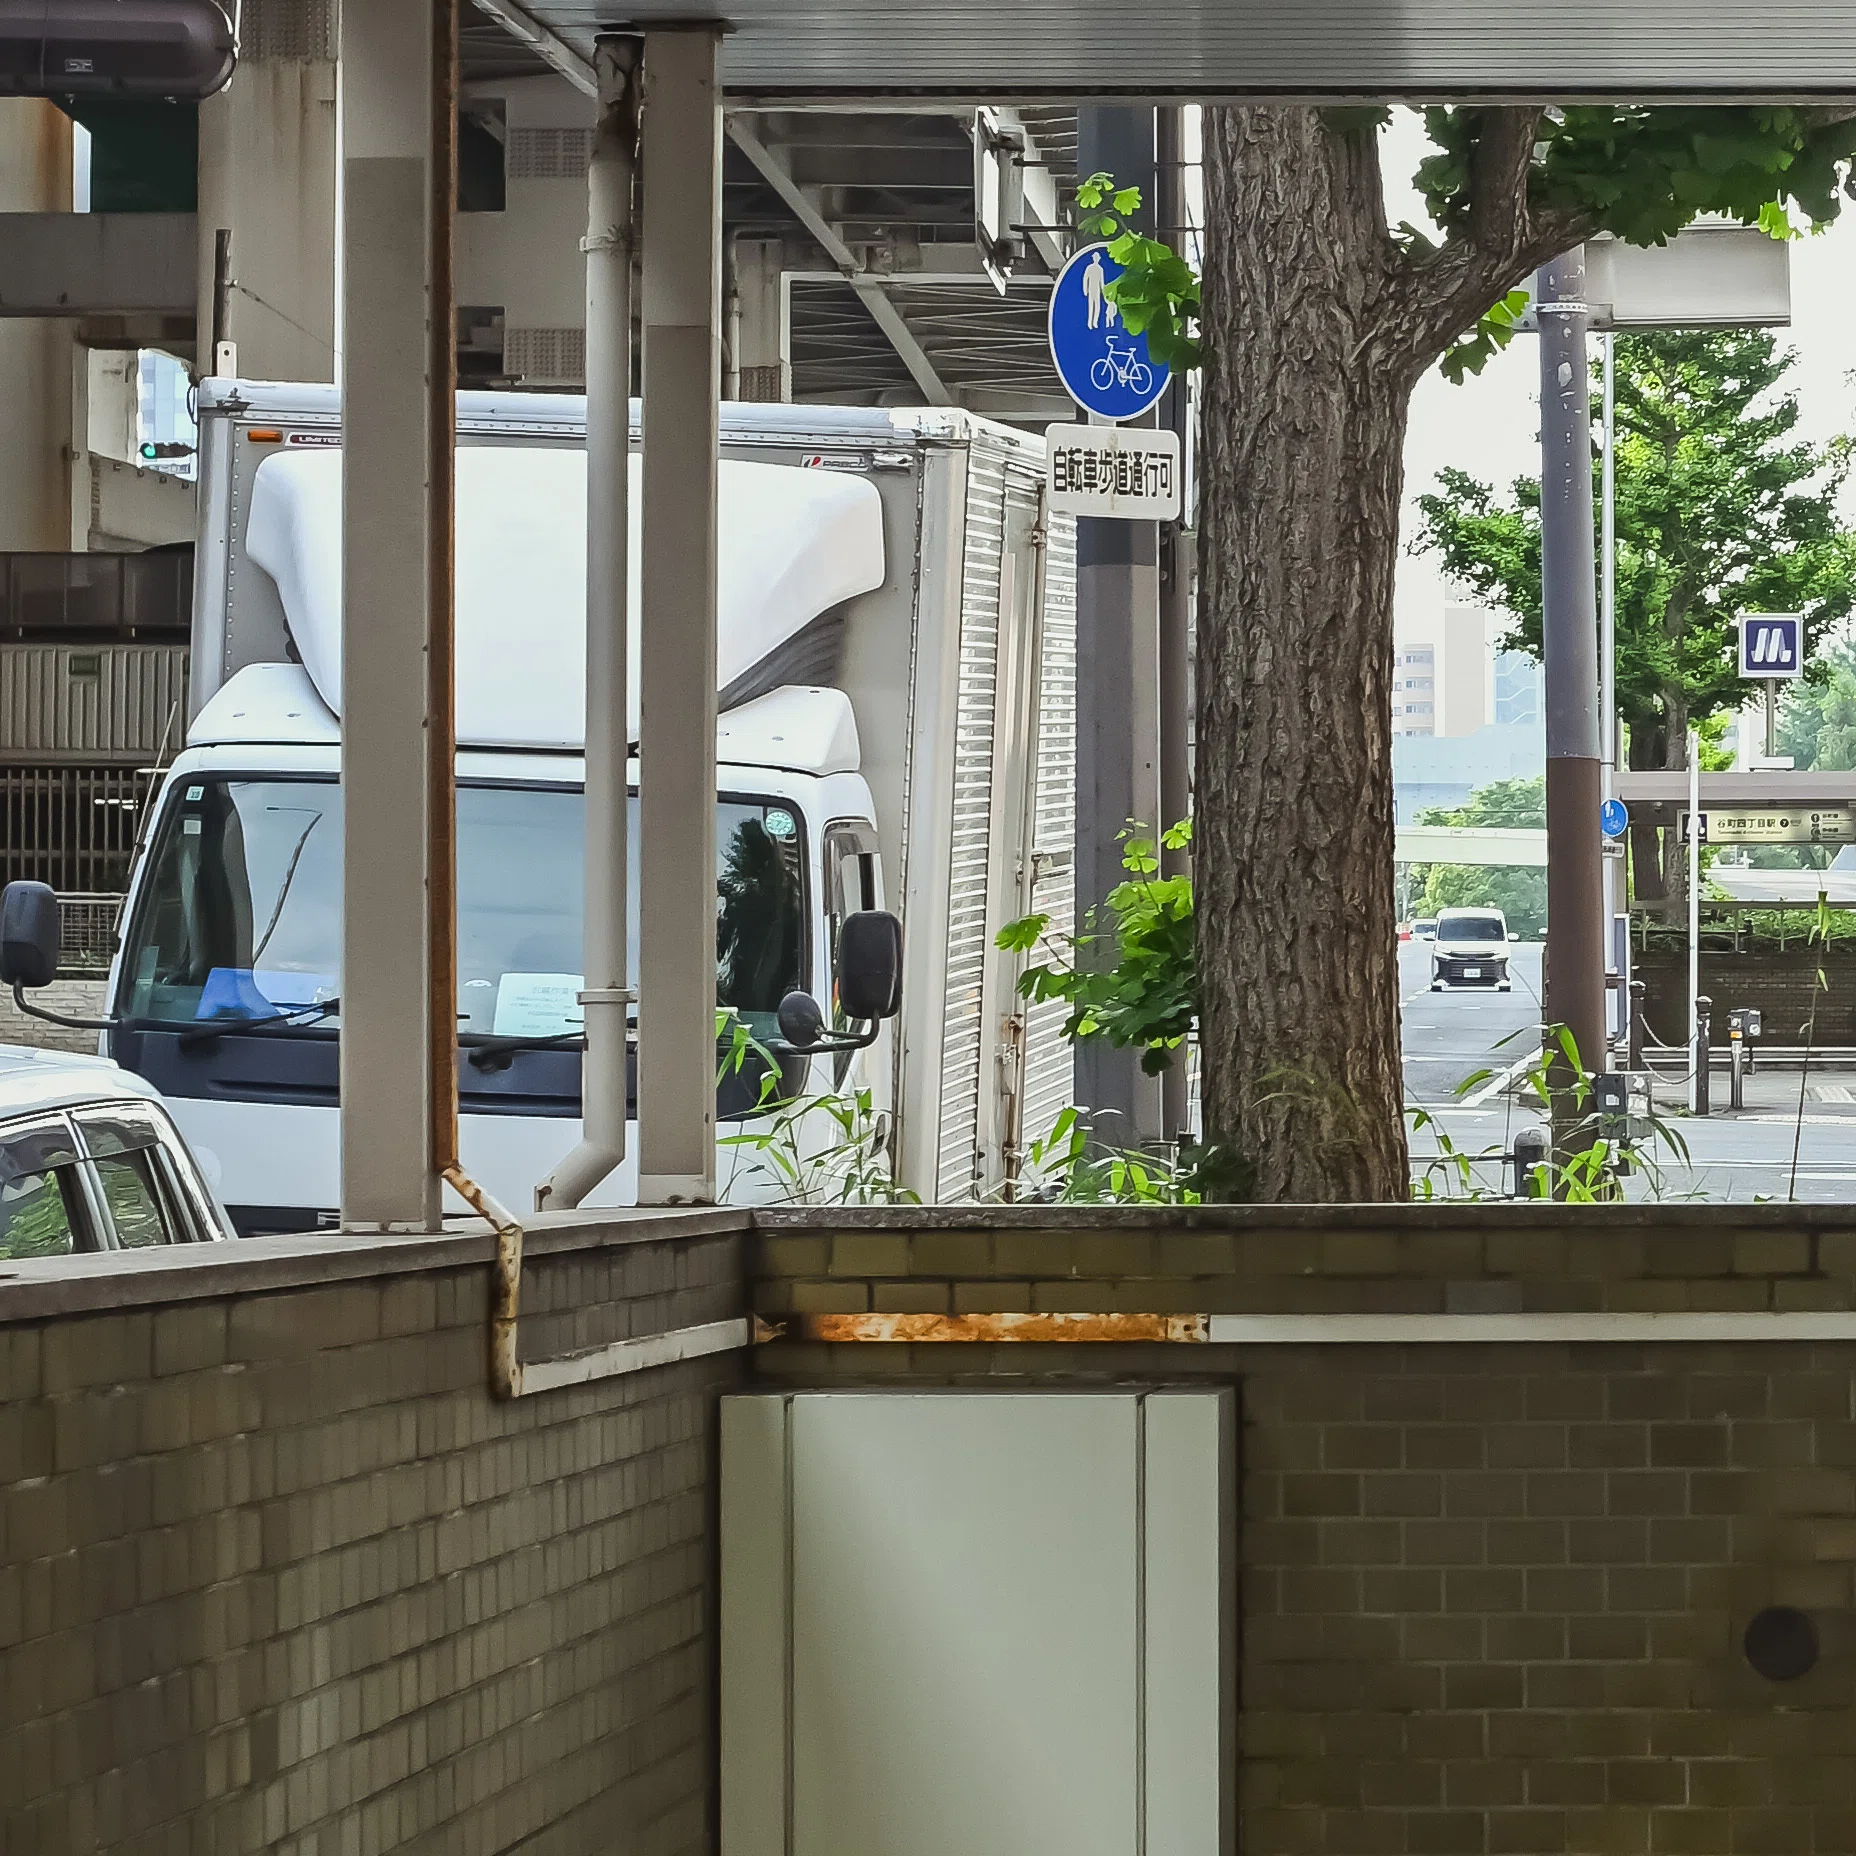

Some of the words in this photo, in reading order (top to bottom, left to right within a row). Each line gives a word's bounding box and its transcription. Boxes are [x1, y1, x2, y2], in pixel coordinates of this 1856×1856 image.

[1053, 445, 1174, 499] 自転車歩道通行可
